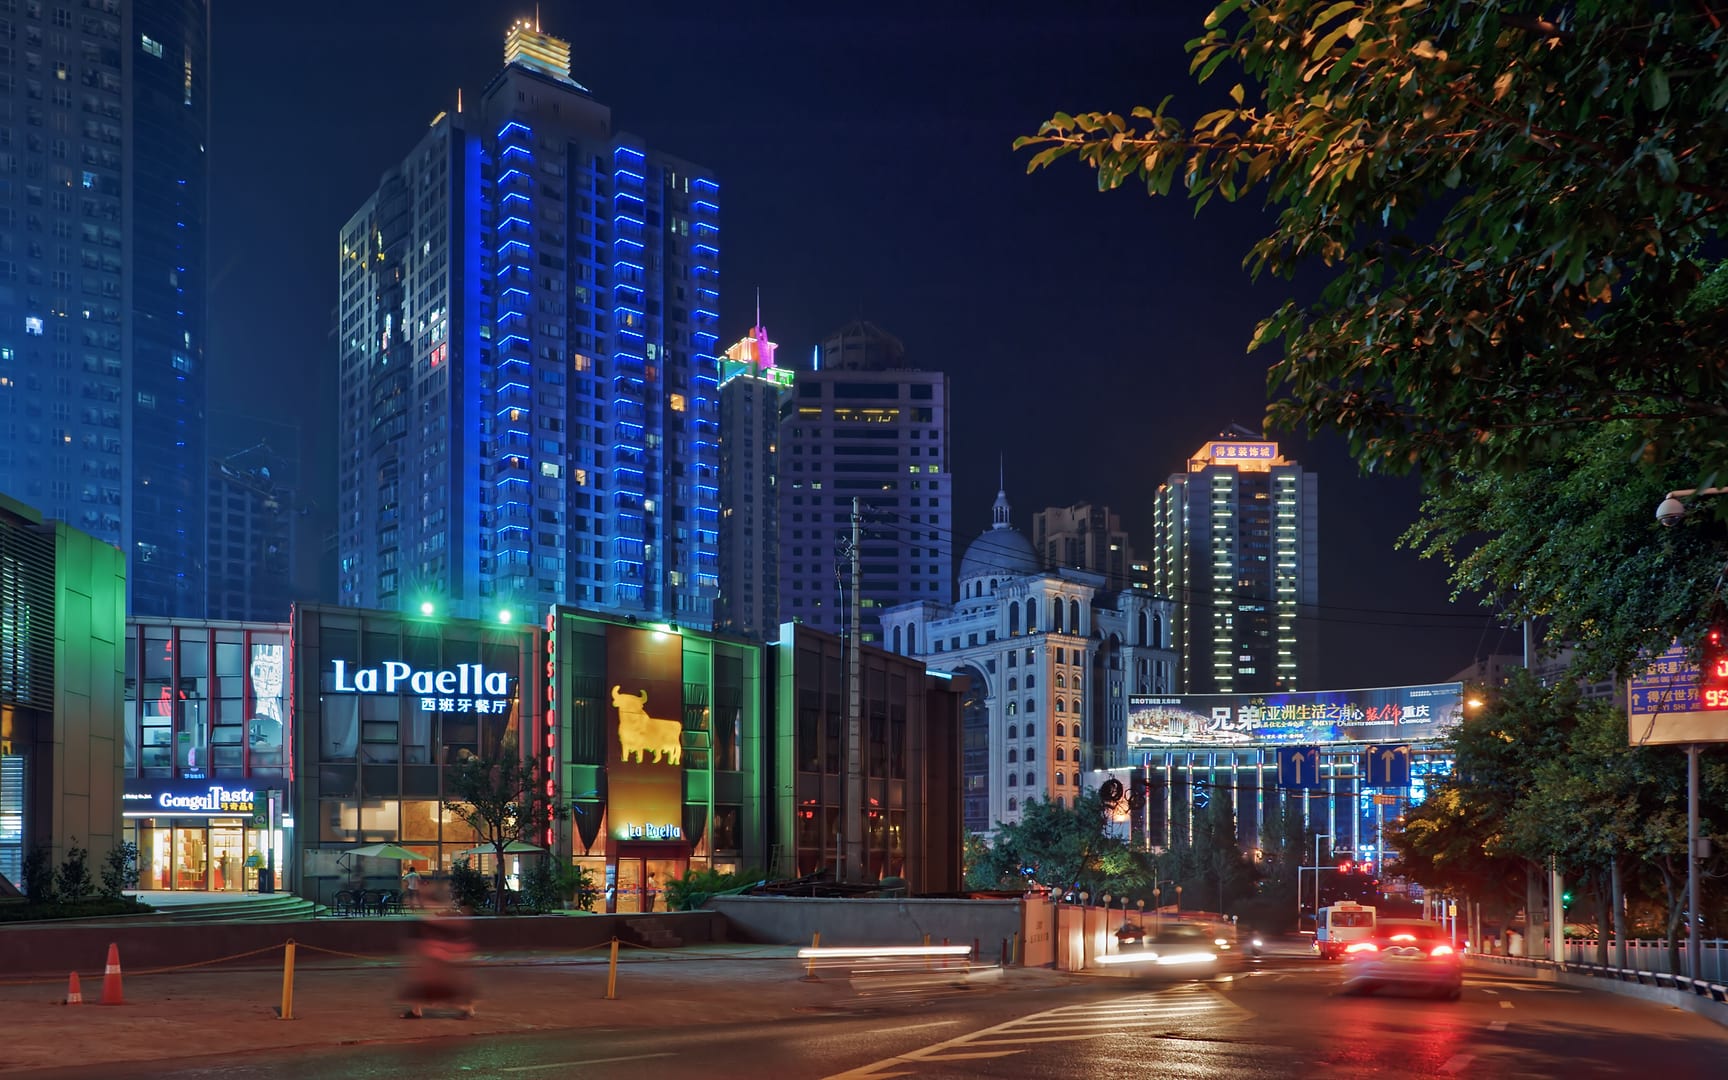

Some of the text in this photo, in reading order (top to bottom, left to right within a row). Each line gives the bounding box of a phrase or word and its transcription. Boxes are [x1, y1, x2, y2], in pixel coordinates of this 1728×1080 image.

[332, 659, 507, 695] La Paella
[1647, 688, 1699, 703] 得意世界
[421, 697, 507, 714] 西班牙餐厅
[627, 823, 681, 839] La Paella
